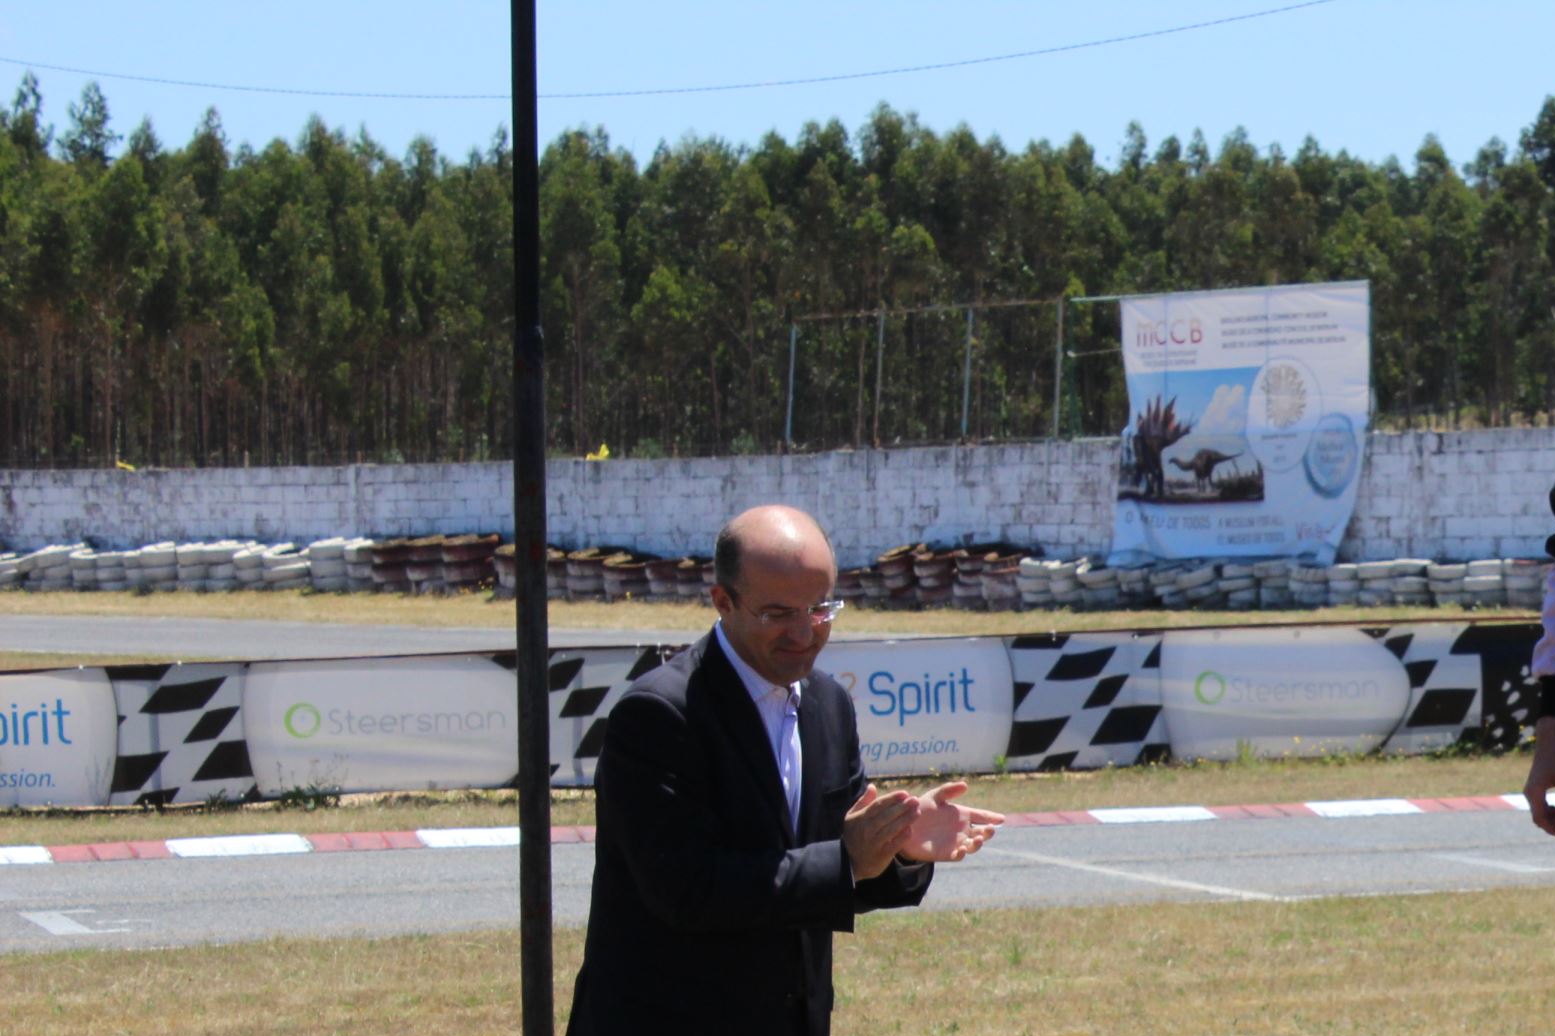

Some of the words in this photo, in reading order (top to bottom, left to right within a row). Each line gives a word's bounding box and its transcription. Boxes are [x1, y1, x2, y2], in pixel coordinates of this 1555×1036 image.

[868, 667, 977, 727] Spirit
[1231, 676, 1380, 703] Steersman
[328, 707, 507, 735] Steersman
[886, 736, 960, 761] passion.
